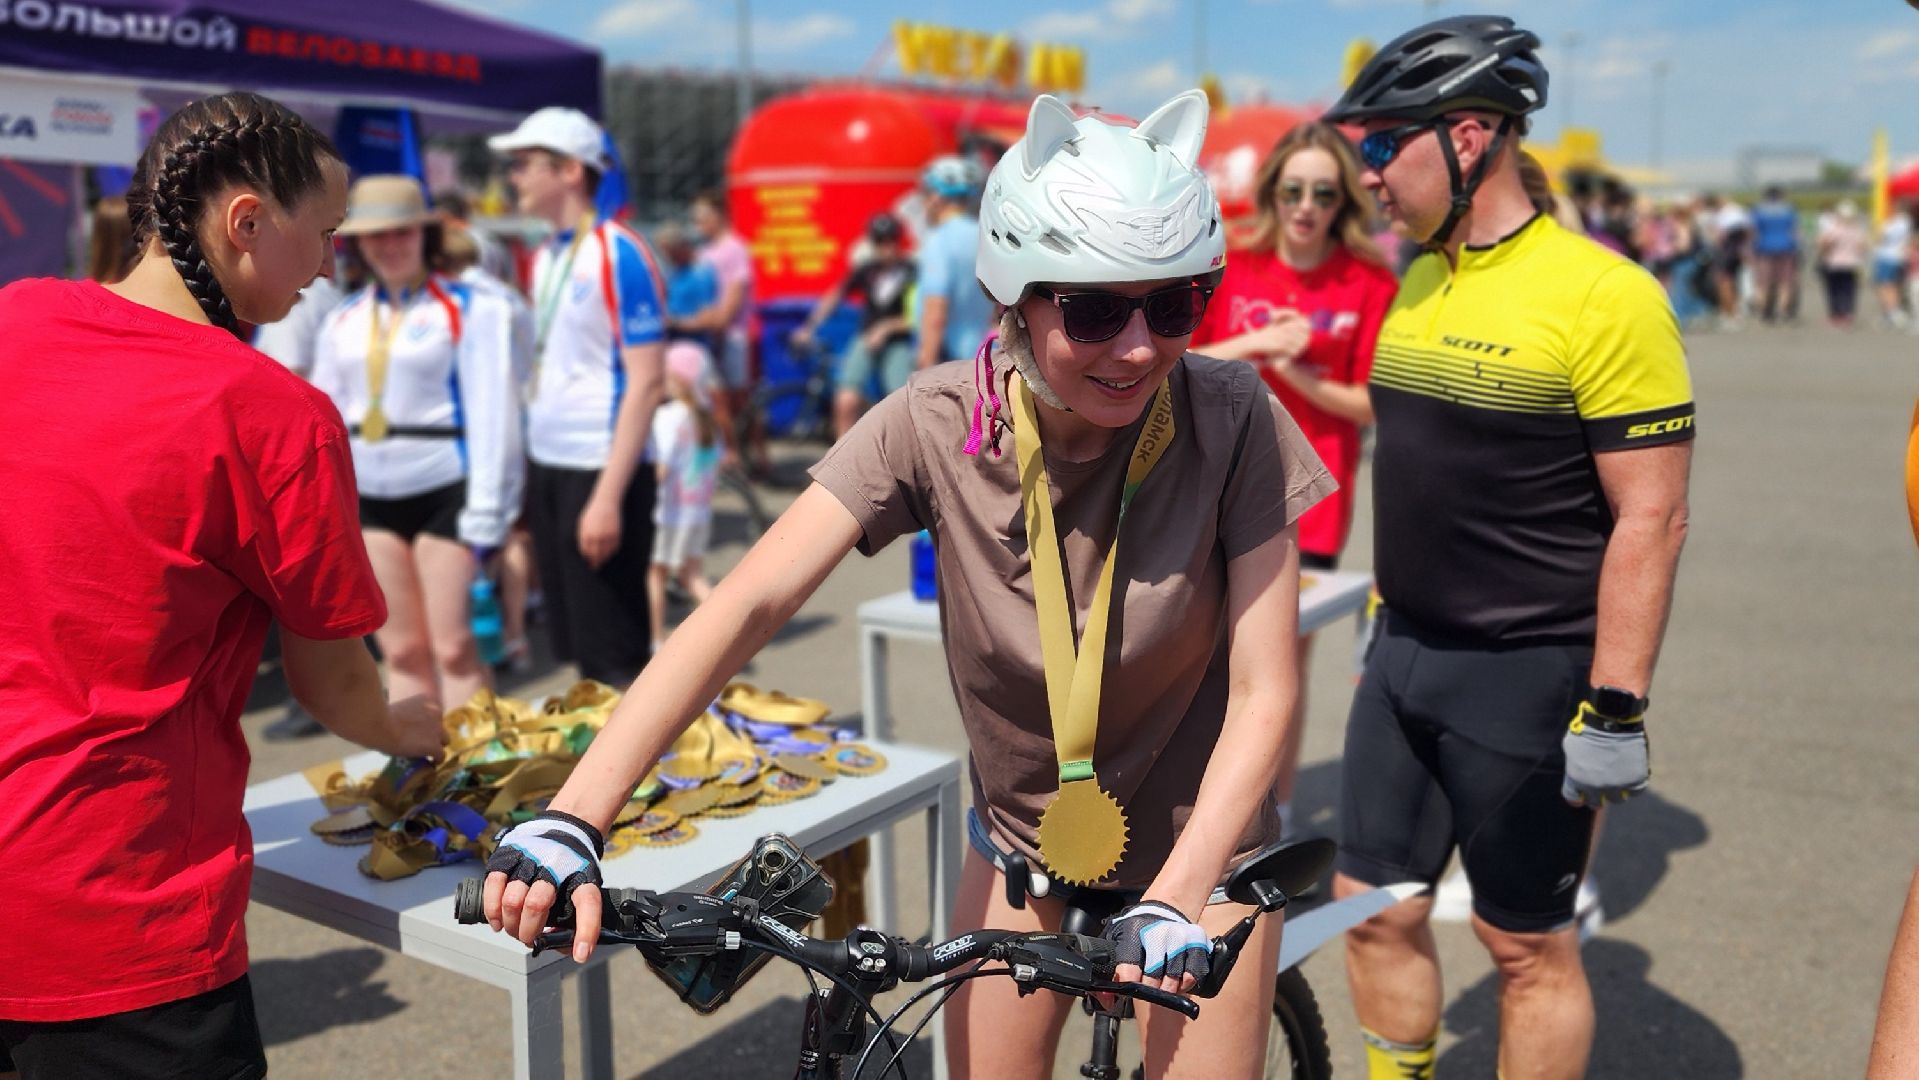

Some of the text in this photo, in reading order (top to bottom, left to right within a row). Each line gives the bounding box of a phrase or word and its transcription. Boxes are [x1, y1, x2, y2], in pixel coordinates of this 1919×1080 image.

[0, 0, 238, 50] ОЛЬШОЙ
[1442, 335, 1518, 356] SCOTT
[1625, 416, 1696, 438] SCOT
